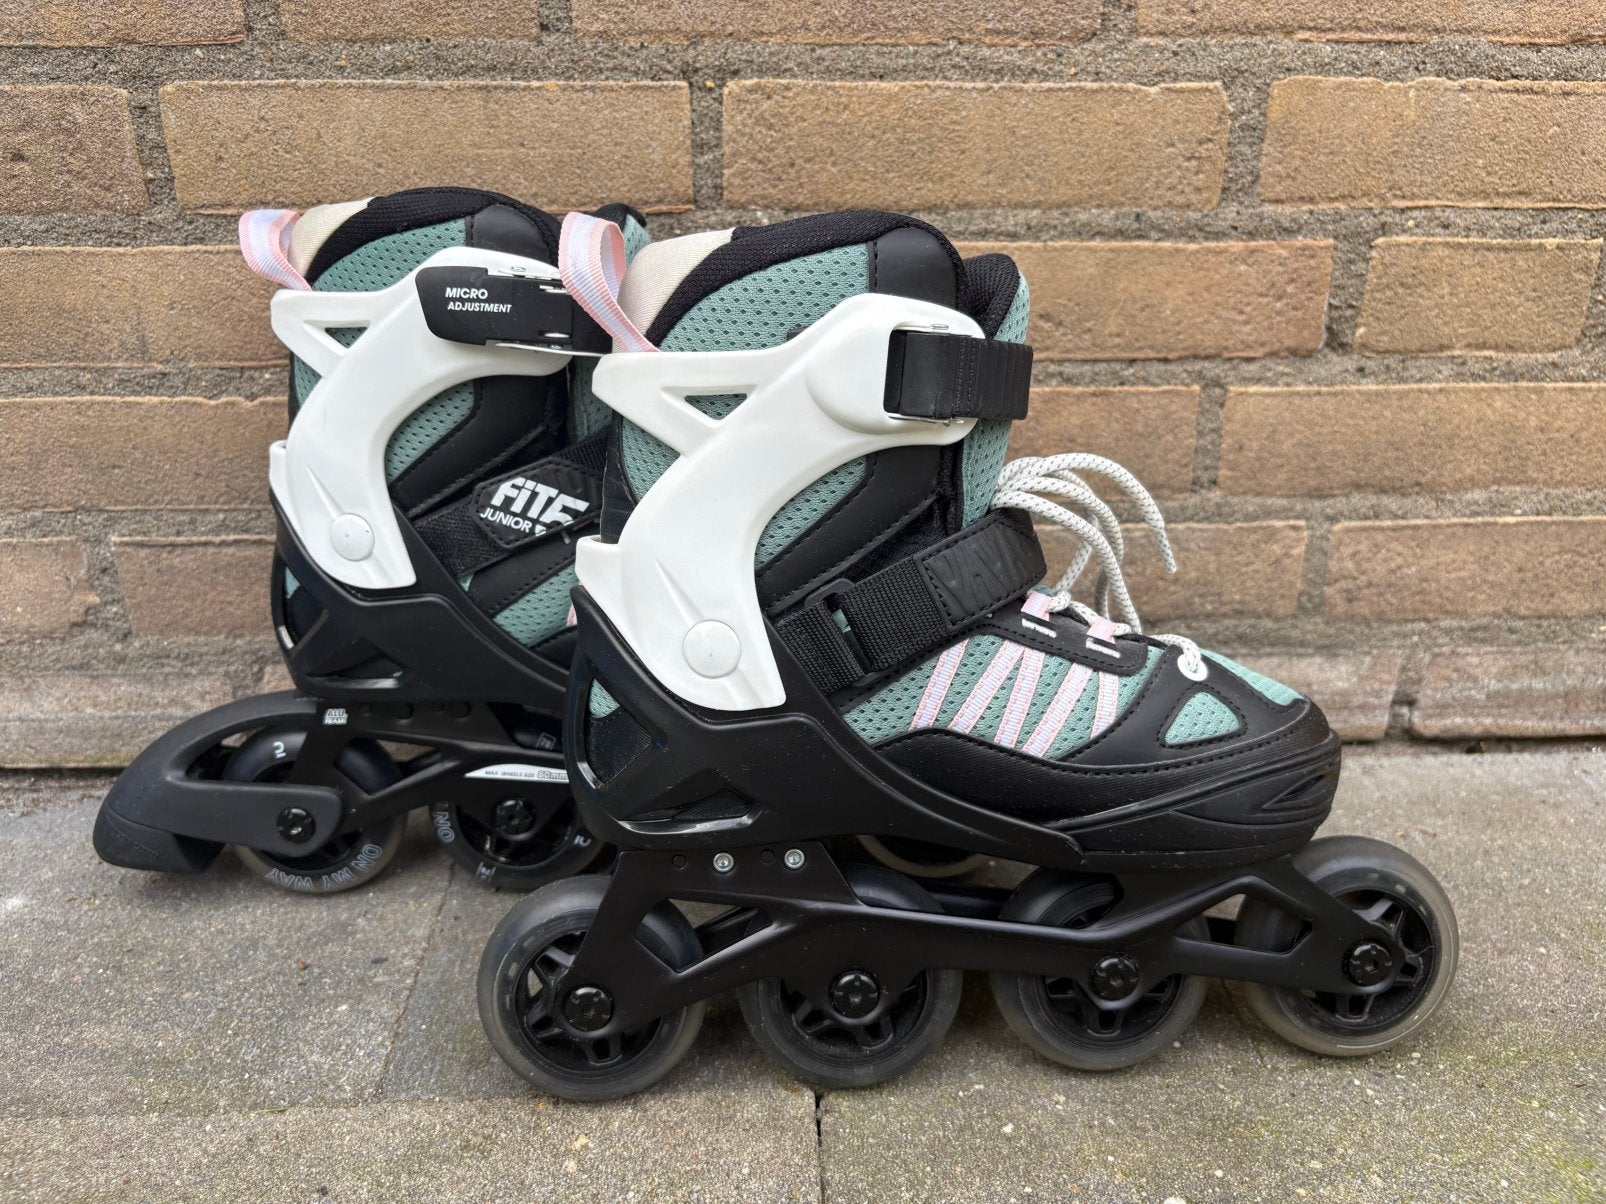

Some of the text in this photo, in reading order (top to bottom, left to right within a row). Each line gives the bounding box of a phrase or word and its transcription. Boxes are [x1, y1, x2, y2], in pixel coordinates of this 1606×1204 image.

[445, 287, 489, 299] MICRO
[447, 302, 512, 313] ADJUSTMENT
[480, 507, 533, 533] JUNIOR
[264, 843, 383, 890] ON MY WAY
